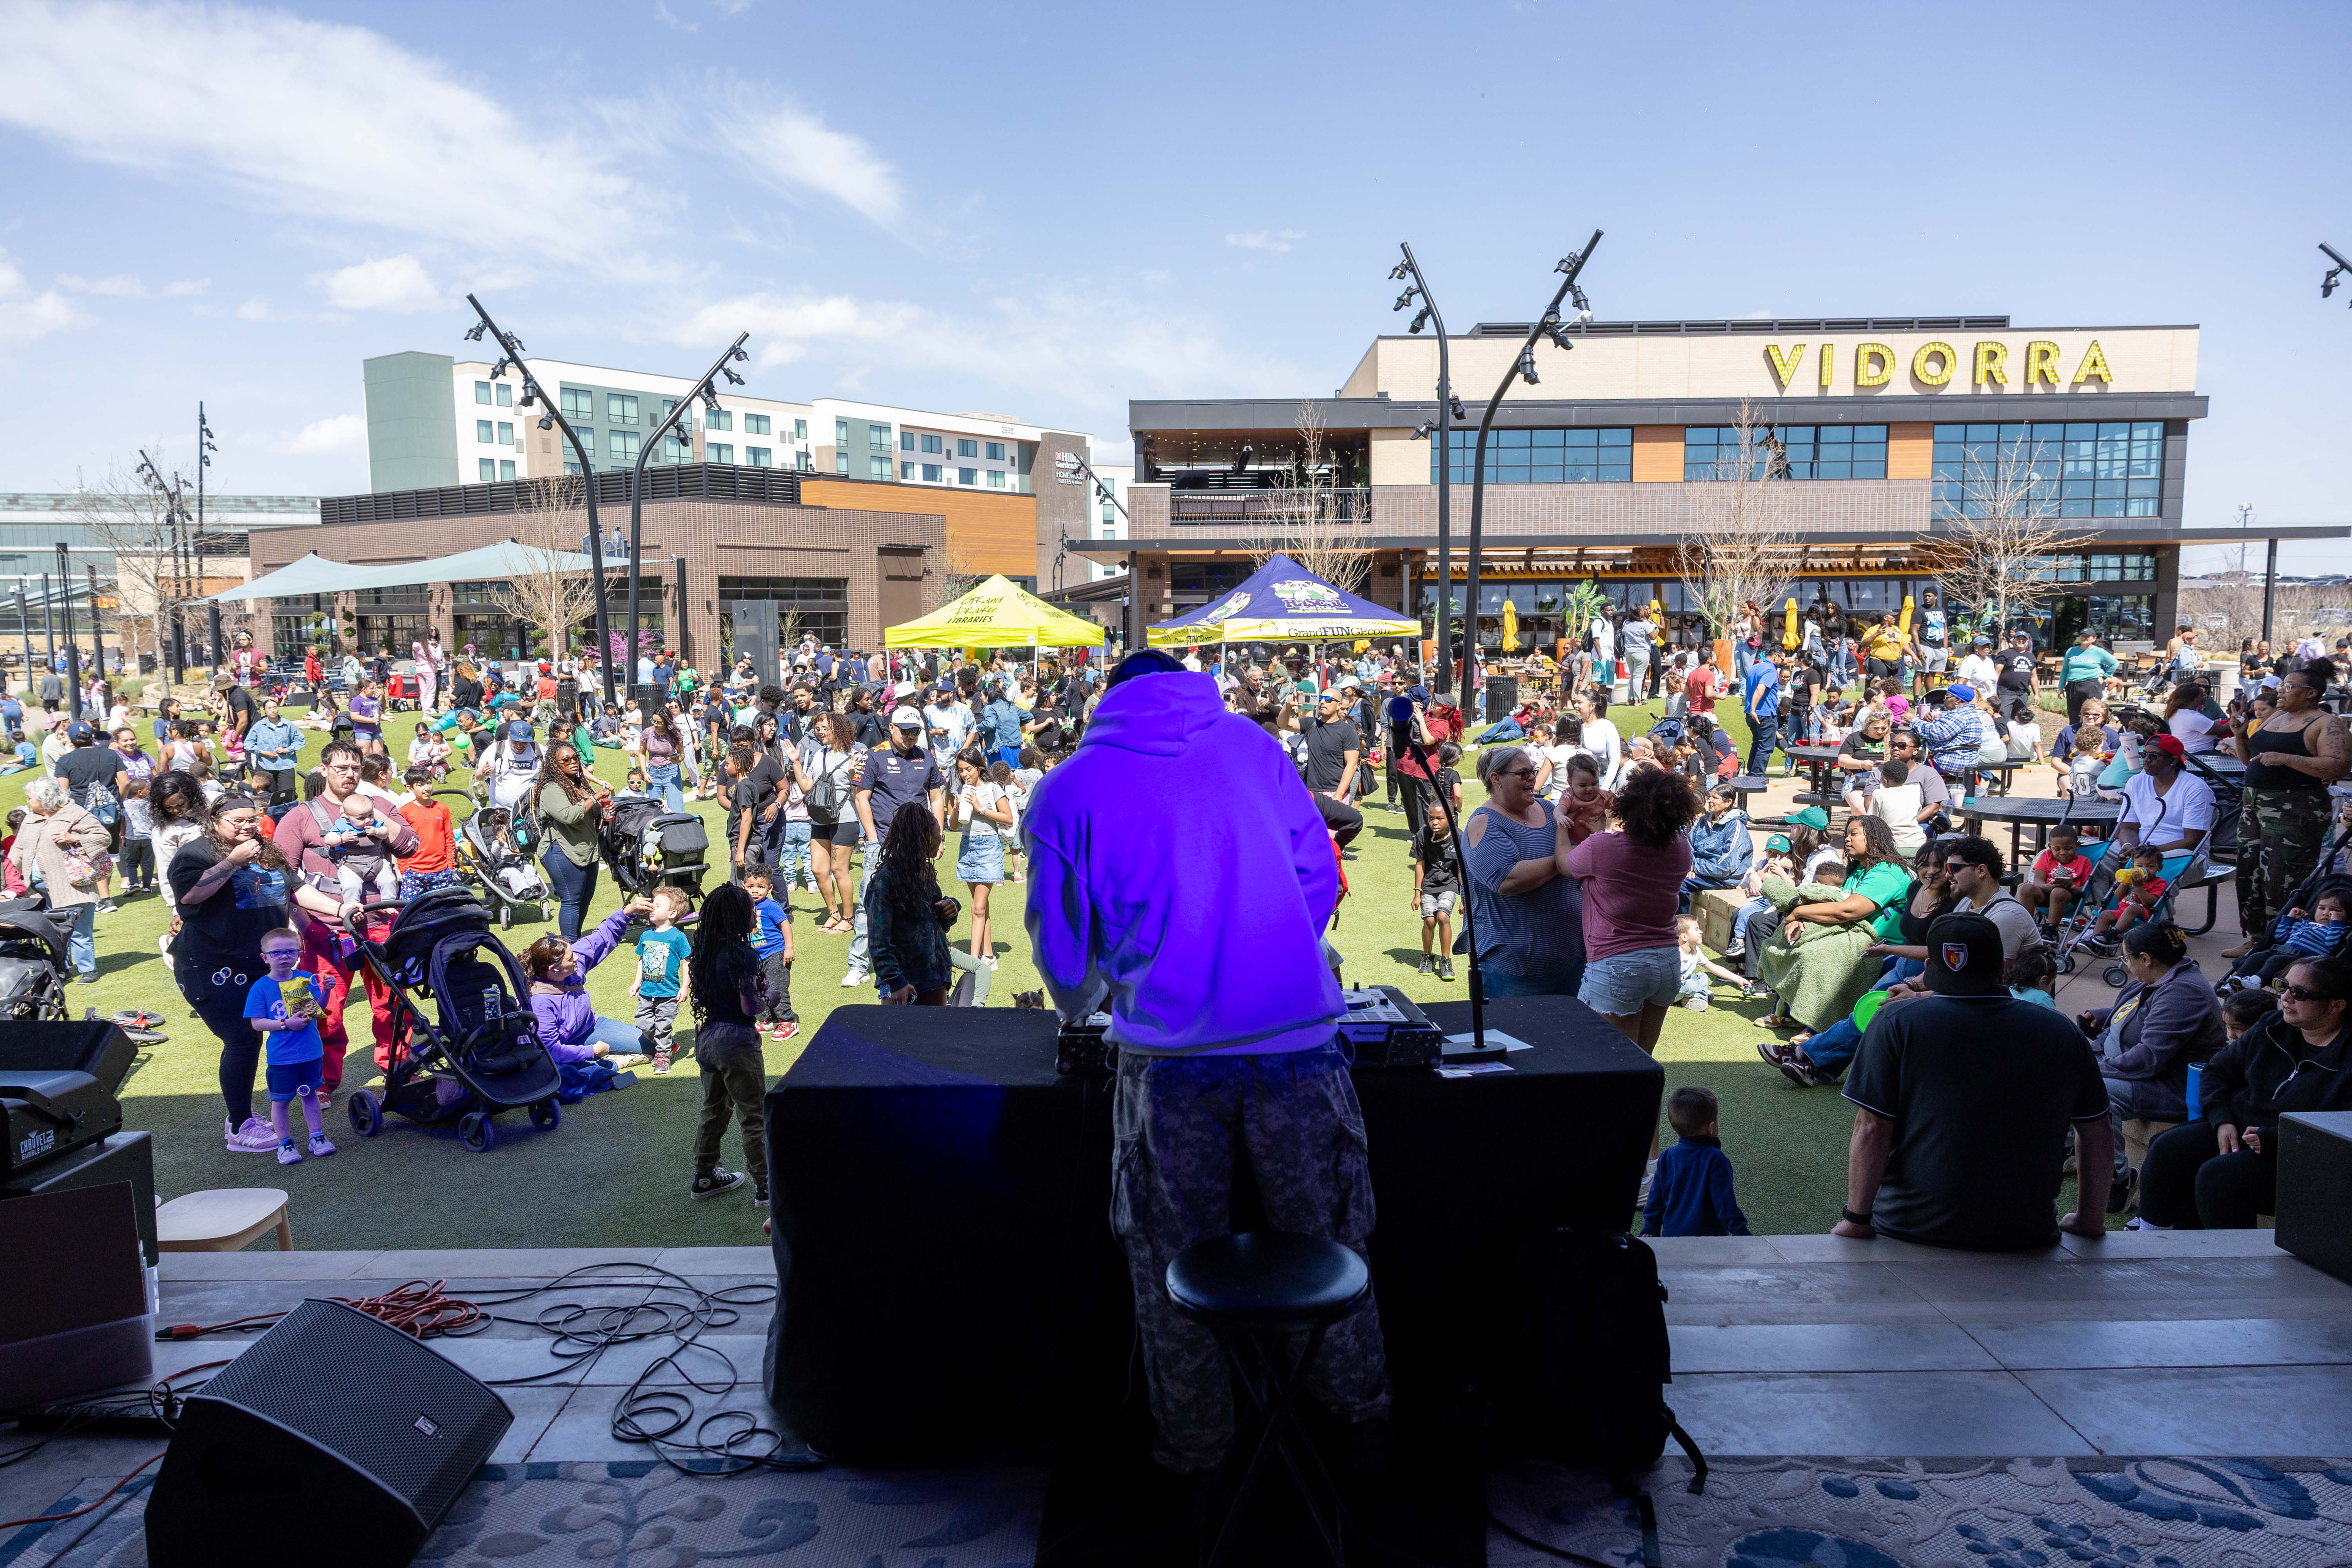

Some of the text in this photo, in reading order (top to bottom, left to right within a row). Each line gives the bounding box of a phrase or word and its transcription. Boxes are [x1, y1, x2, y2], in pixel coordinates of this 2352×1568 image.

[1766, 340, 2113, 387] VIDORRA
[1055, 461, 1074, 470] Garden
[947, 616, 994, 624] LIBRARIES
[1288, 626, 1390, 638] GrandFUNGP.com
[20, 1132, 45, 1154] CHAUVET
[22, 1147, 40, 1160] BUBBLE
